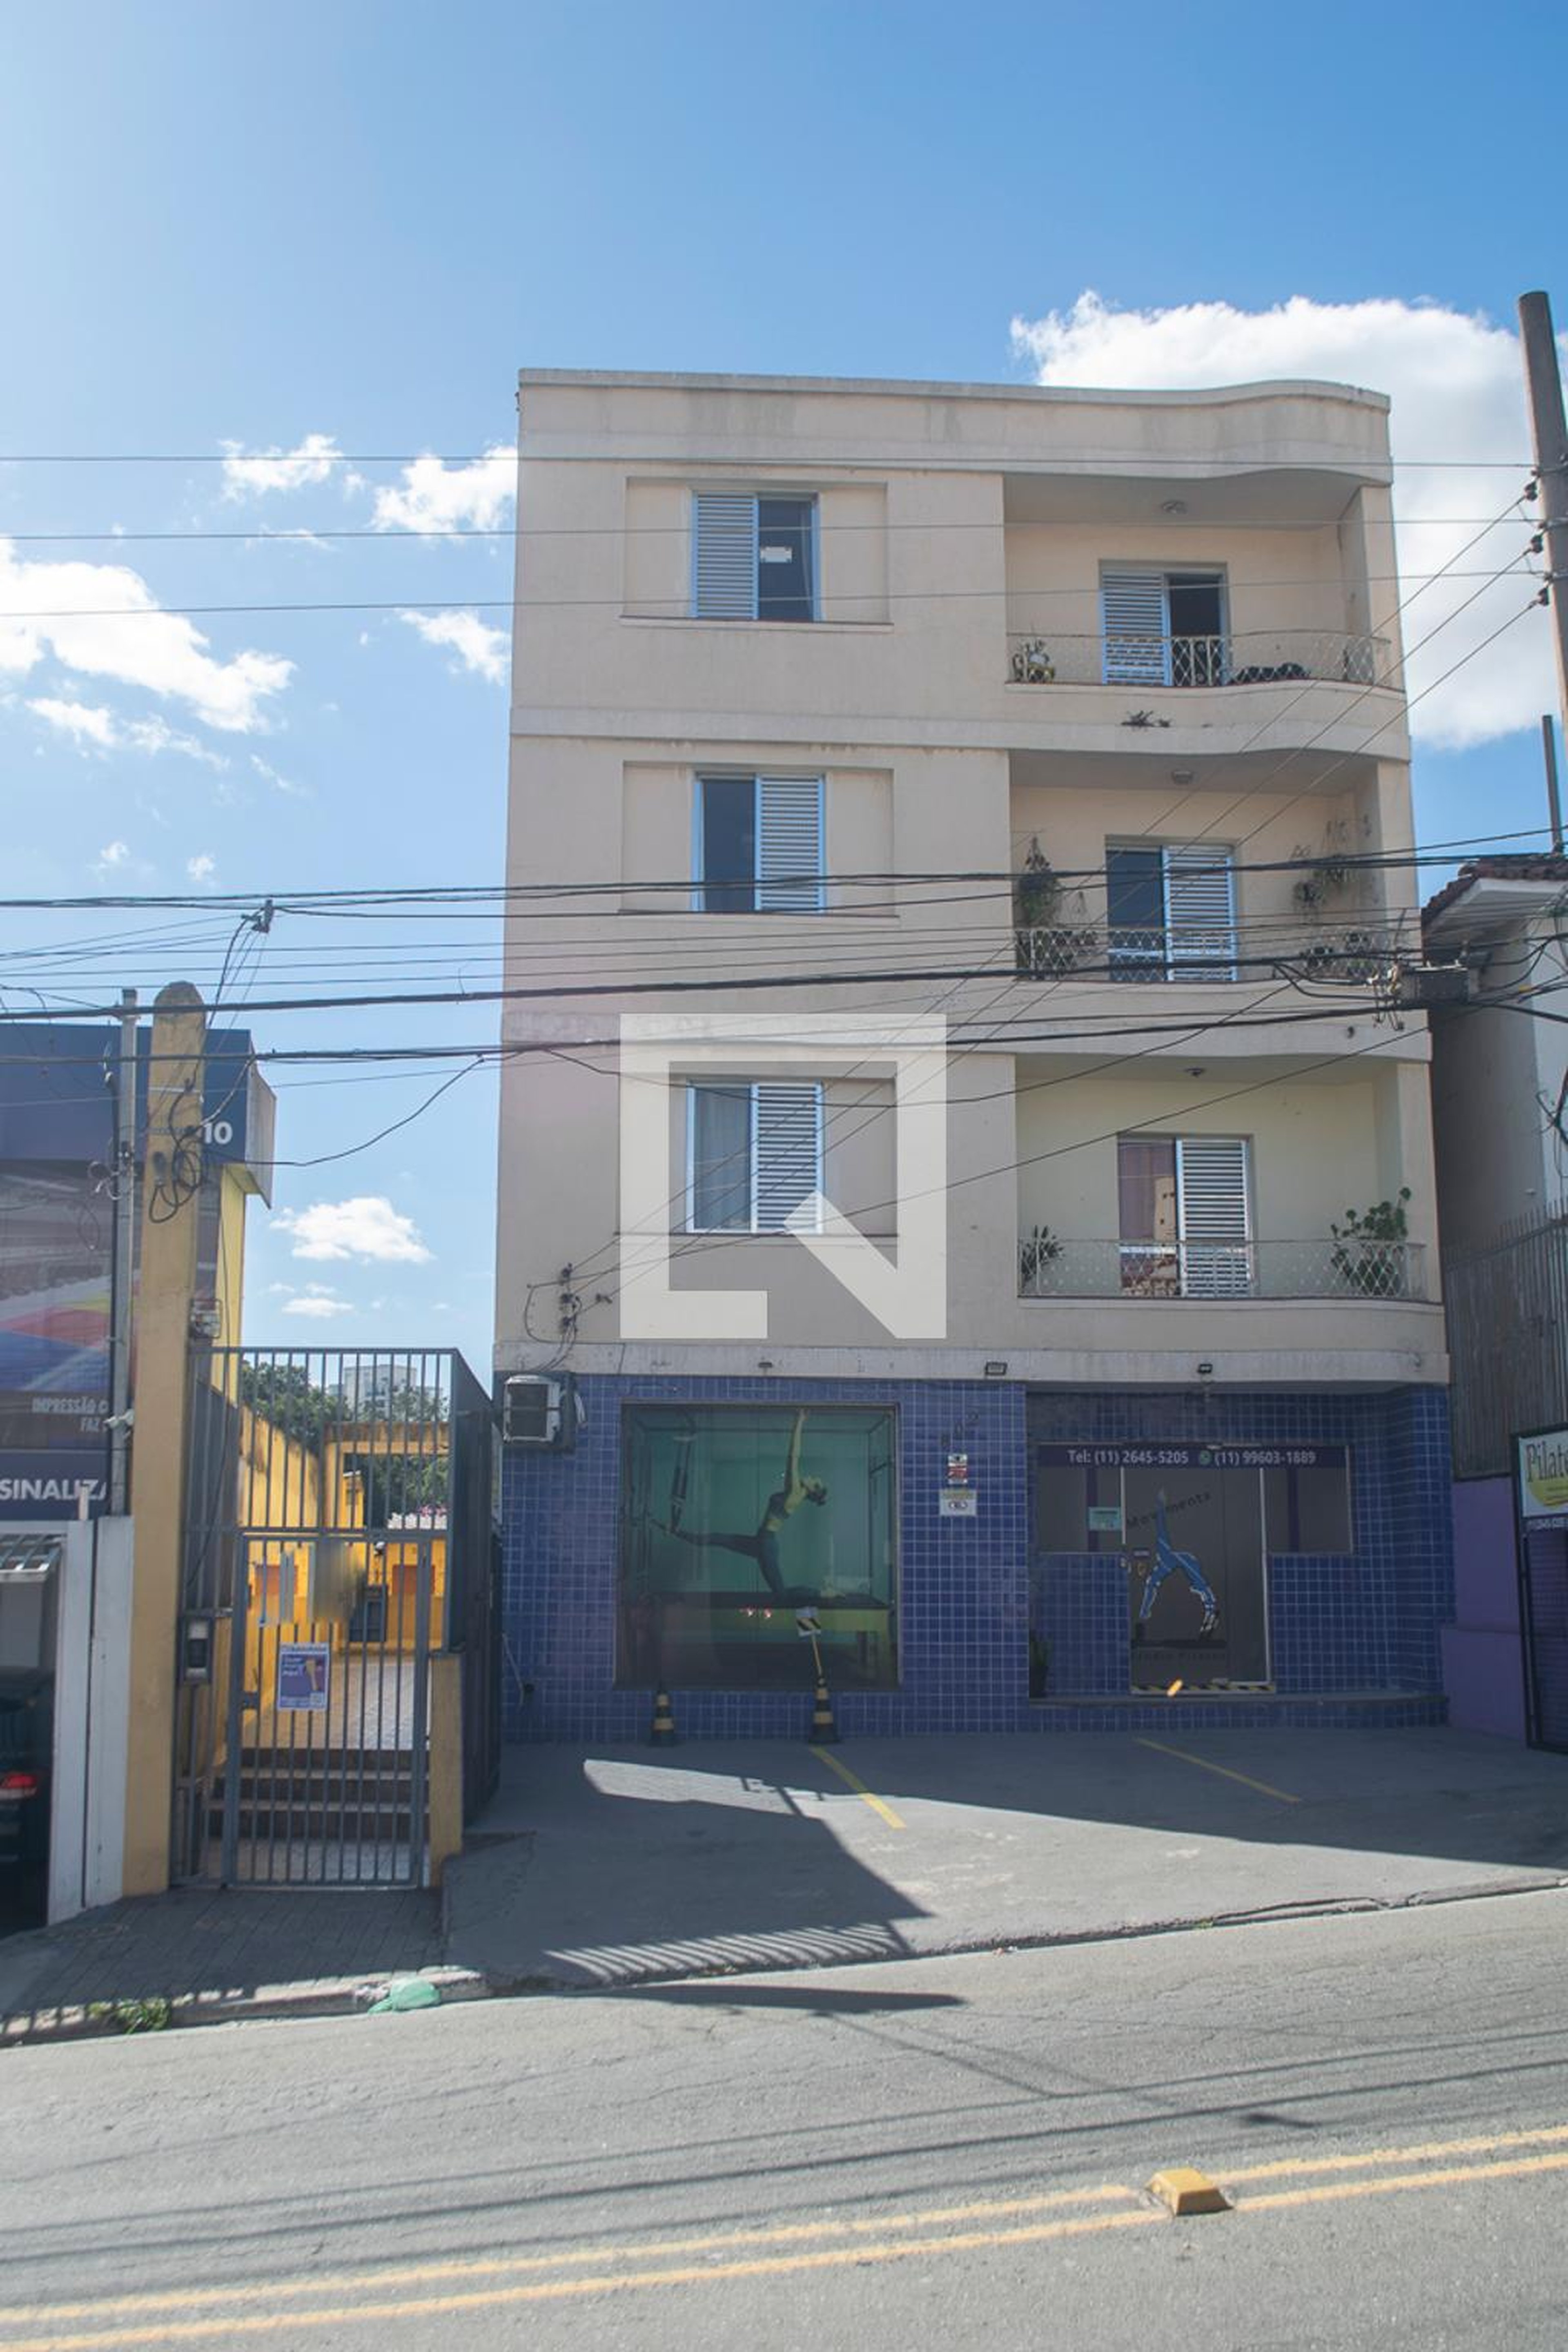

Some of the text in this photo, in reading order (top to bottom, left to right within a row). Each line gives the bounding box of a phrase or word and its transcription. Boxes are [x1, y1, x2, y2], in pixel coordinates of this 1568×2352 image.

[1067, 1450, 1091, 1463] Tel:
[1094, 1450, 1120, 1465] (11)
[1214, 1451, 1240, 1466] (11)
